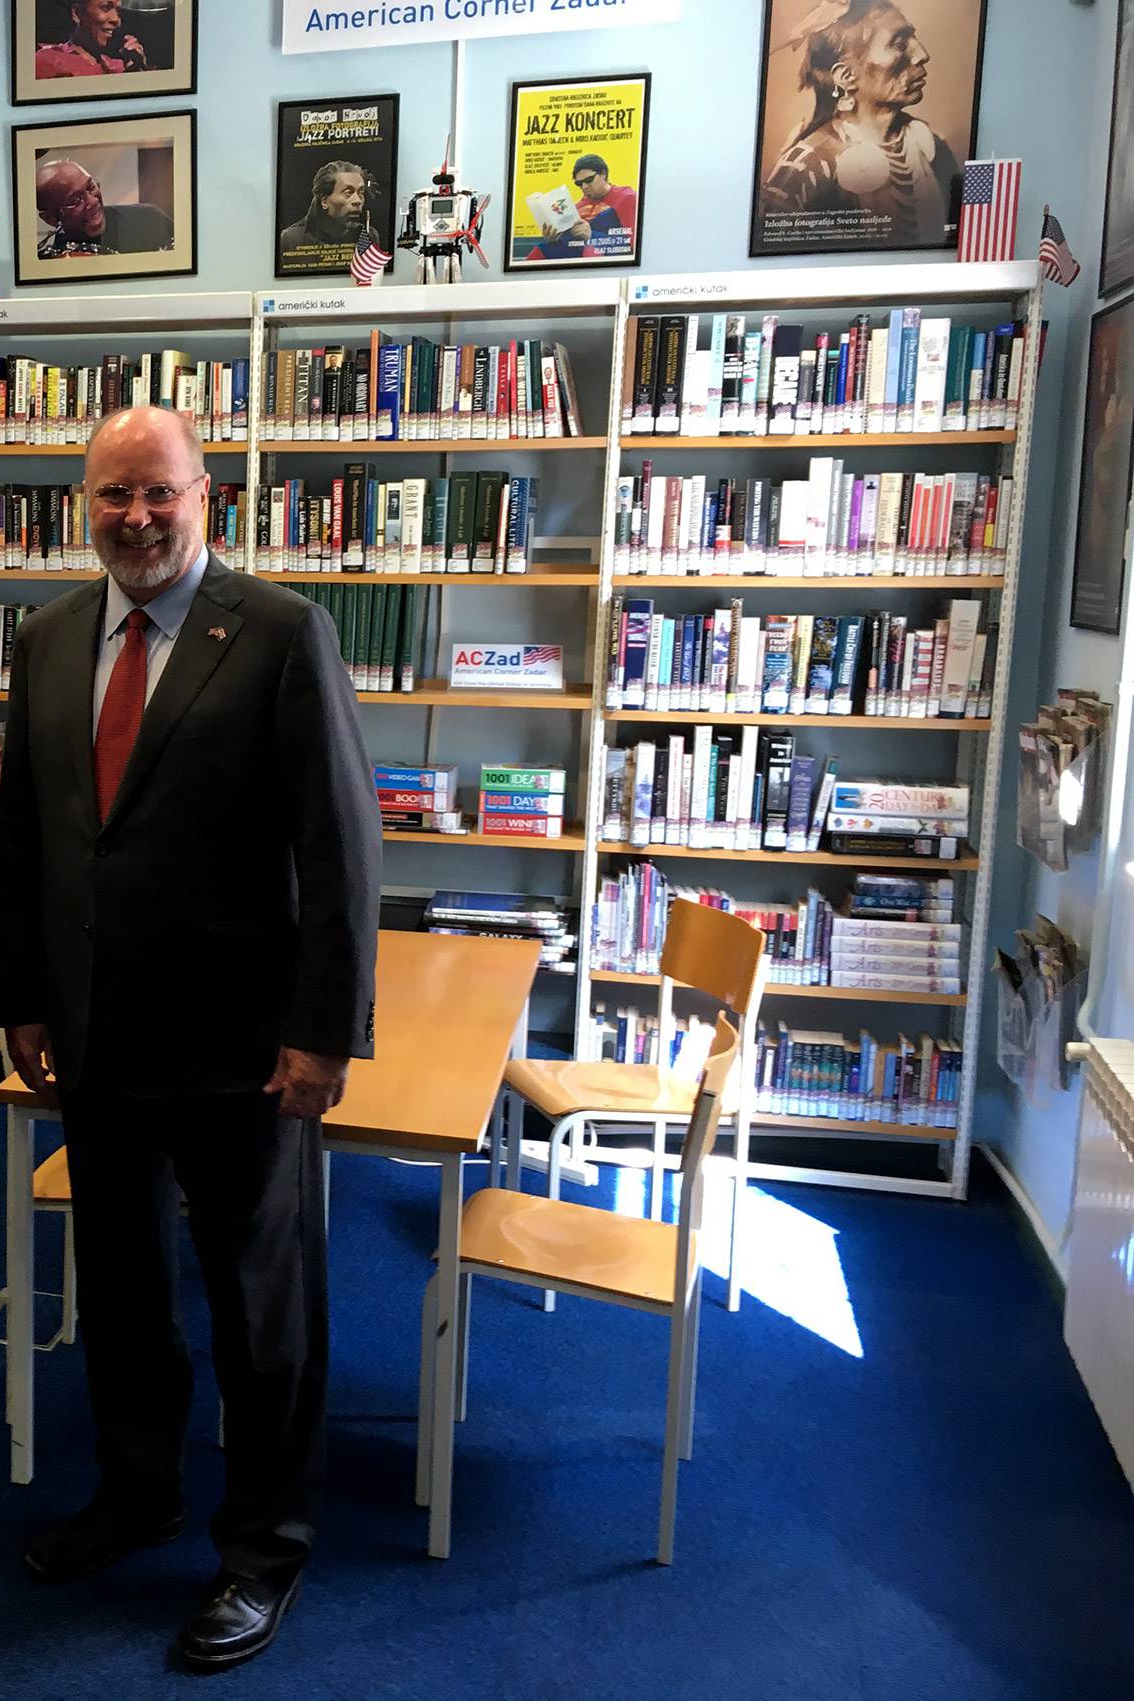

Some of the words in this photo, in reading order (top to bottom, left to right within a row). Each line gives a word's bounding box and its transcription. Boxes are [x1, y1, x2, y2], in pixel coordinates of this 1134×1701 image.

[306, 2, 434, 33] American
[524, 113, 560, 136] JAZZ
[565, 108, 635, 133] KONCERT
[297, 129, 324, 142] JAZZ
[327, 127, 379, 139] PORTRETI
[608, 227, 633, 236] ARSENAL
[765, 219, 794, 228] Izložba
[795, 217, 835, 228] fotografija
[836, 216, 858, 226] Sveto
[652, 284, 697, 297] američki
[700, 284, 728, 294] kutak
[278, 299, 318, 311] američki
[320, 298, 346, 309] kutak
[516, 355, 526, 378] KING
[817, 348, 826, 372] WORLD
[284, 355, 292, 397] PRESIDENT
[356, 373, 368, 382] NO
[384, 348, 400, 393] TRUMAN
[297, 364, 310, 404] TITAN
[473, 357, 488, 412] LINDBERGH
[546, 384, 555, 398] ALEX
[354, 382, 368, 412] ORDINARY
[333, 482, 342, 504] LOUIS
[404, 484, 419, 518] GRANT
[508, 480, 520, 526] CULTURAL
[333, 504, 342, 520] VAN
[298, 524, 306, 544] Suárez
[332, 520, 342, 540] GAAL
[846, 624, 860, 643] BATTLE
[455, 650, 521, 666] ACZad
[844, 643, 857, 653] CRY
[454, 667, 493, 675] American
[523, 668, 547, 676] Zadar
[841, 660, 854, 685] FREEDOM
[486, 773, 509, 784] 1001
